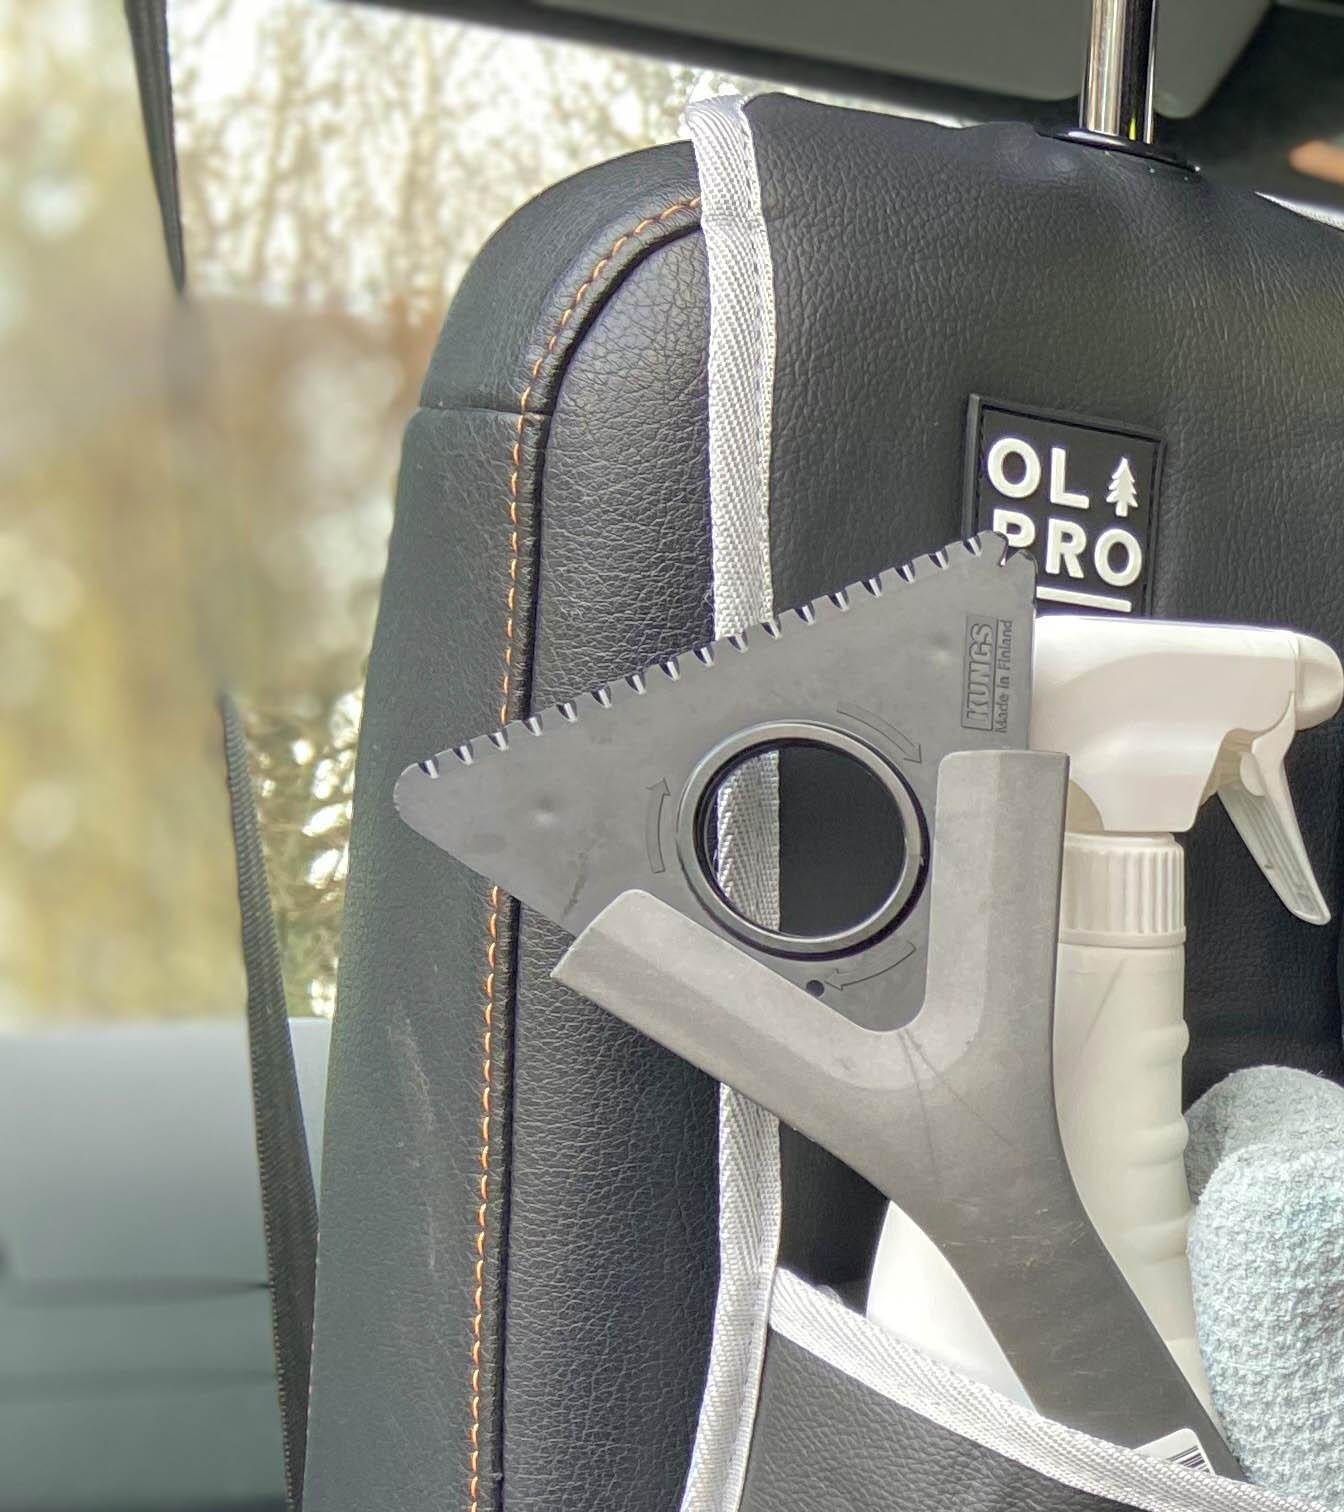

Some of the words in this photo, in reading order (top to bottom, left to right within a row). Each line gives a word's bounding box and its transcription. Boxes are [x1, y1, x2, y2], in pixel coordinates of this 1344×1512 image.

[987, 438, 1090, 509] OL
[993, 508, 1143, 587] PRO
[966, 623, 992, 724] KUNGS
[997, 620, 1013, 671] Finland
[997, 676, 1010, 689] in
